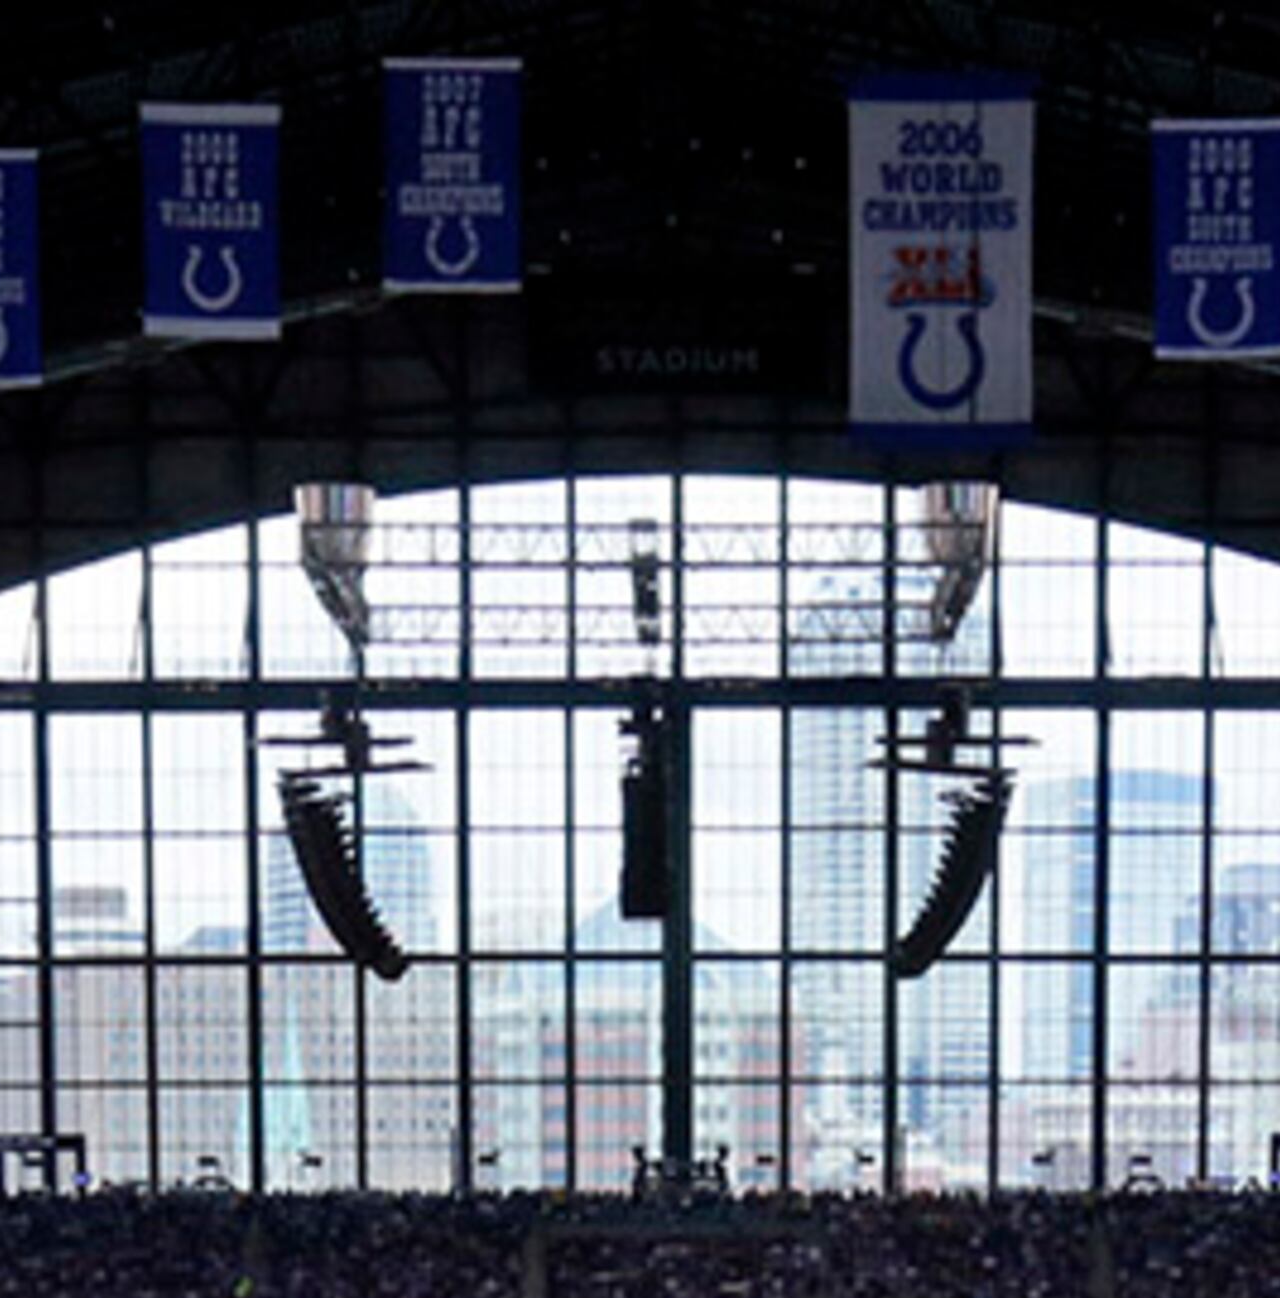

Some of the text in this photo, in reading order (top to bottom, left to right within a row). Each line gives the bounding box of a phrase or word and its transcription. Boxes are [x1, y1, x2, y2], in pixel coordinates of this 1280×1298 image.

[898, 119, 983, 158] 2006
[880, 163, 1003, 193] WORLD
[863, 198, 1017, 231] CHAMPIONS
[597, 345, 760, 374] STADIUM
